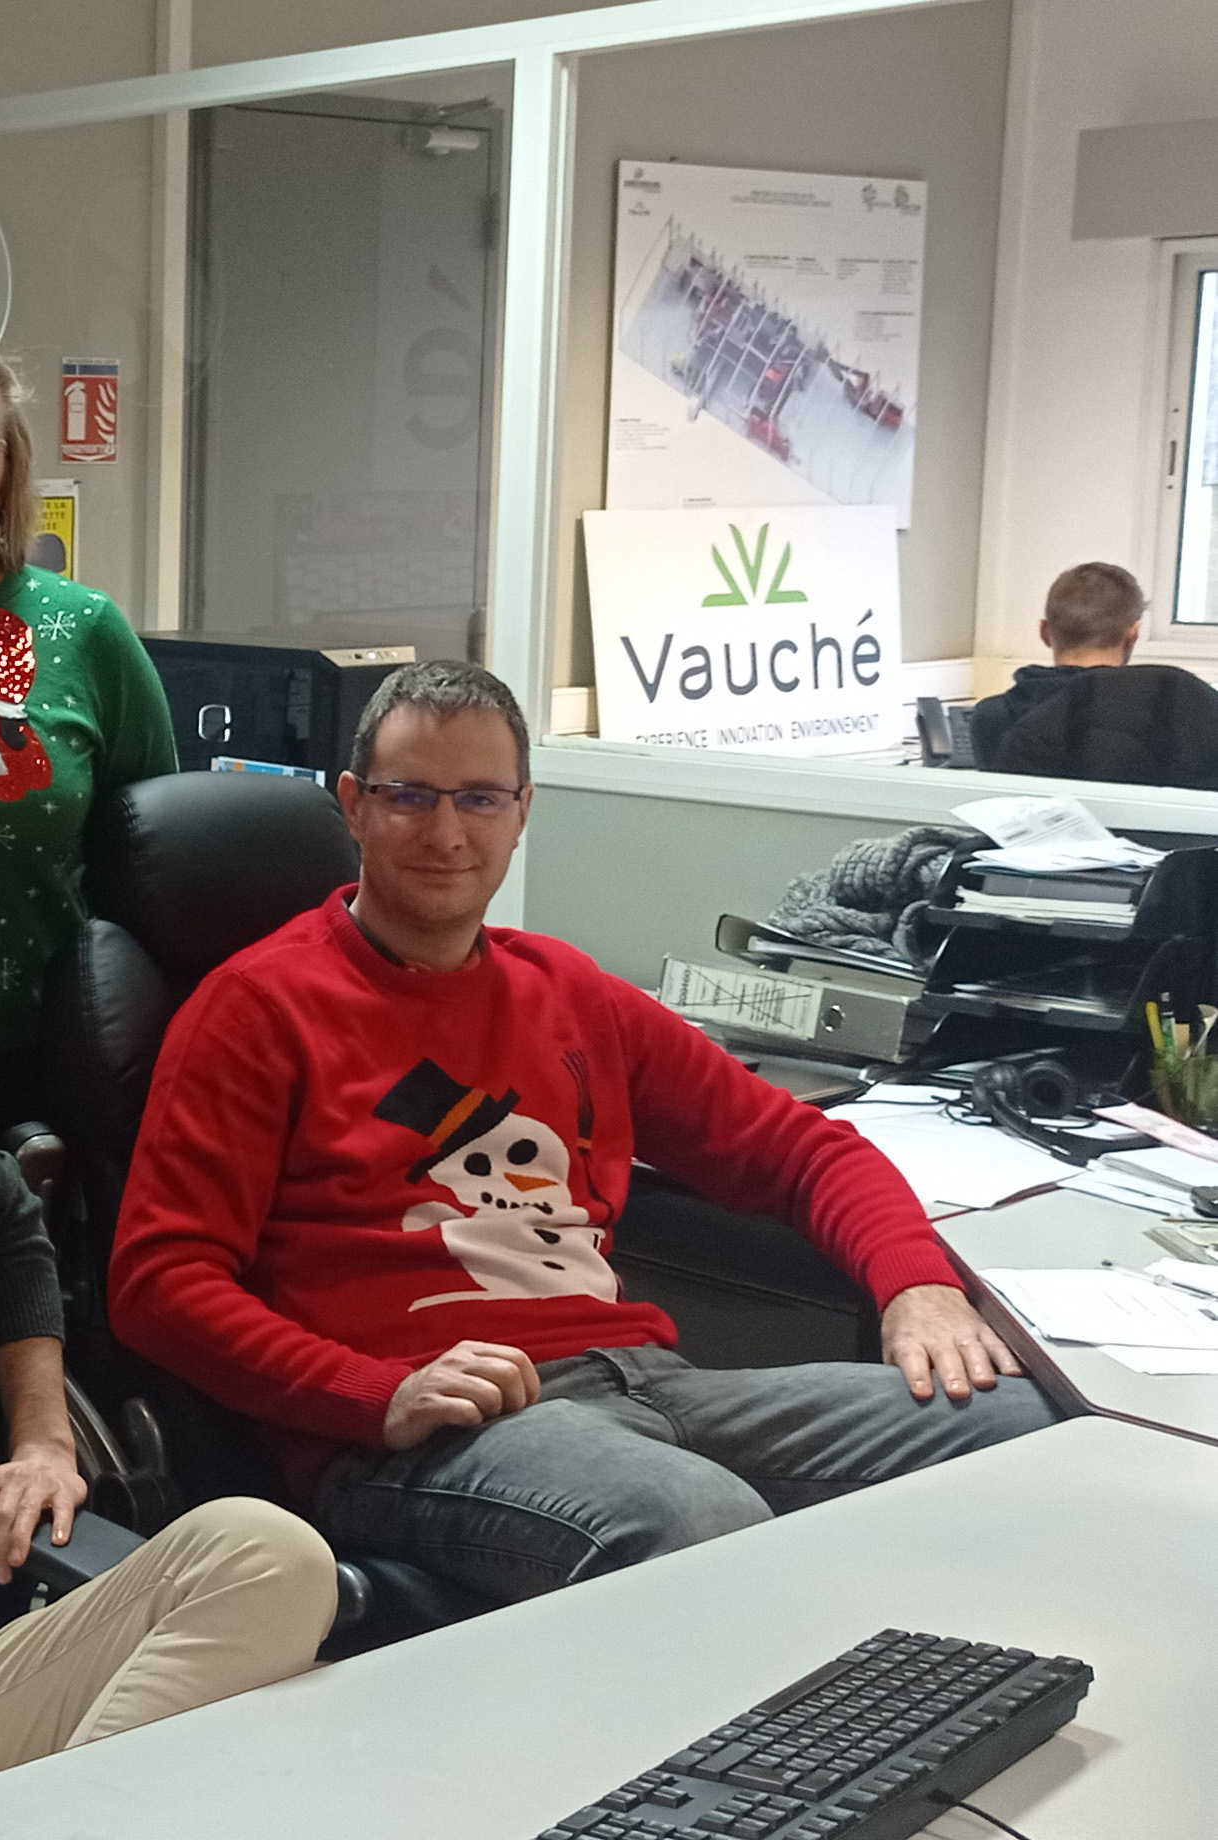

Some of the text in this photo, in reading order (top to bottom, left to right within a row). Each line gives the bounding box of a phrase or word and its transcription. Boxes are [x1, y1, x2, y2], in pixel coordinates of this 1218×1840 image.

[620, 608, 881, 704] Vauché
[717, 723, 783, 746] INNOVATION
[791, 713, 880, 740] ENVIRONNEMENT
